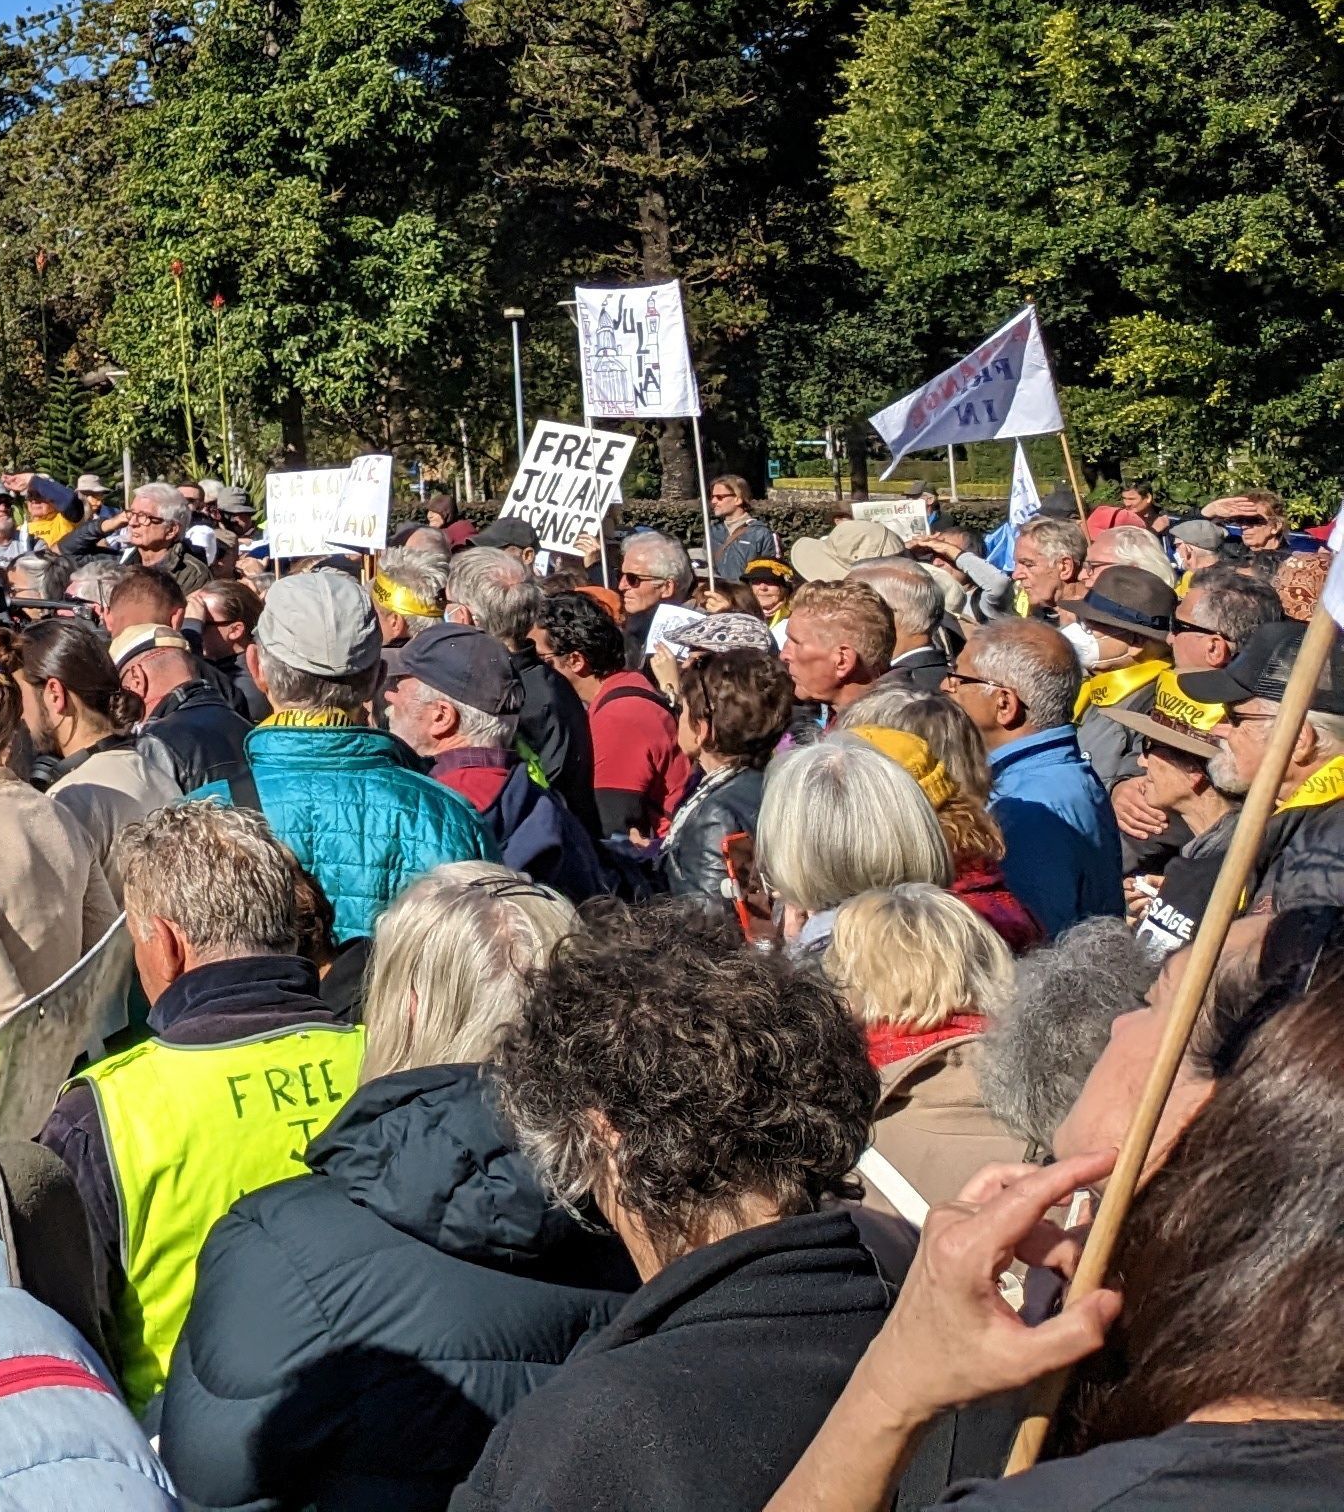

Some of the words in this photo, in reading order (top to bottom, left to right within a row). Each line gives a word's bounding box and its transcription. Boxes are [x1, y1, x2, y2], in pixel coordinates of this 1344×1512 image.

[533, 431, 627, 475] FREE
[512, 468, 614, 513] JULIAN
[227, 1059, 343, 1119] FREE
